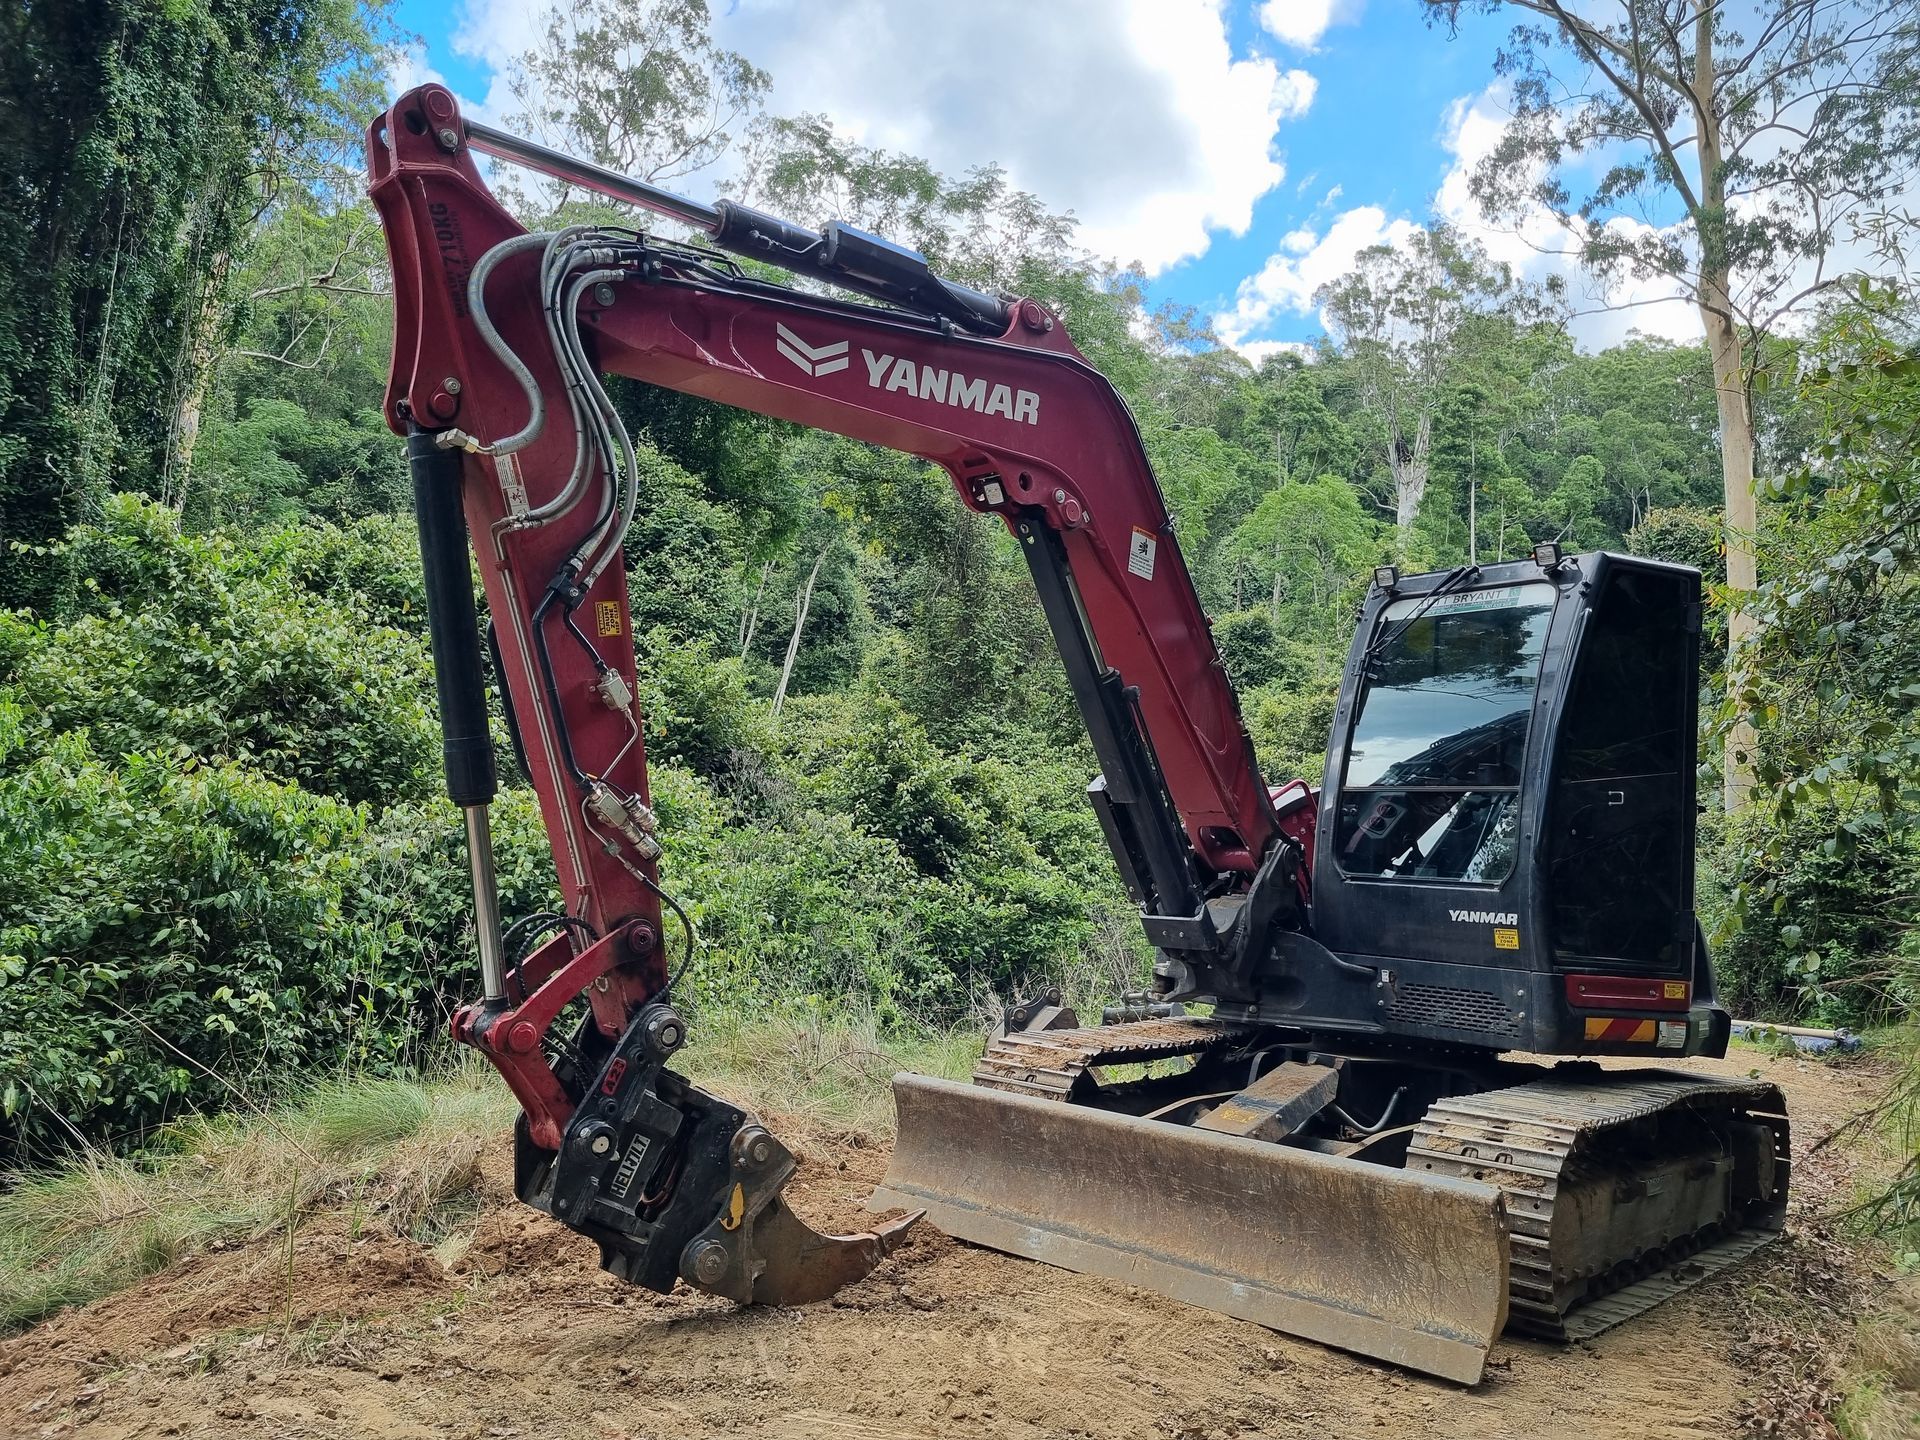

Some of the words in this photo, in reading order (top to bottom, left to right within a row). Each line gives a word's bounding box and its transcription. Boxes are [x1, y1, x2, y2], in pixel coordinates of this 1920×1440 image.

[429, 203, 461, 267] 710KG
[861, 348, 1040, 425] YANMAR
[1453, 590, 1503, 604] BRYANT
[1448, 909, 1518, 926] YANMAR
